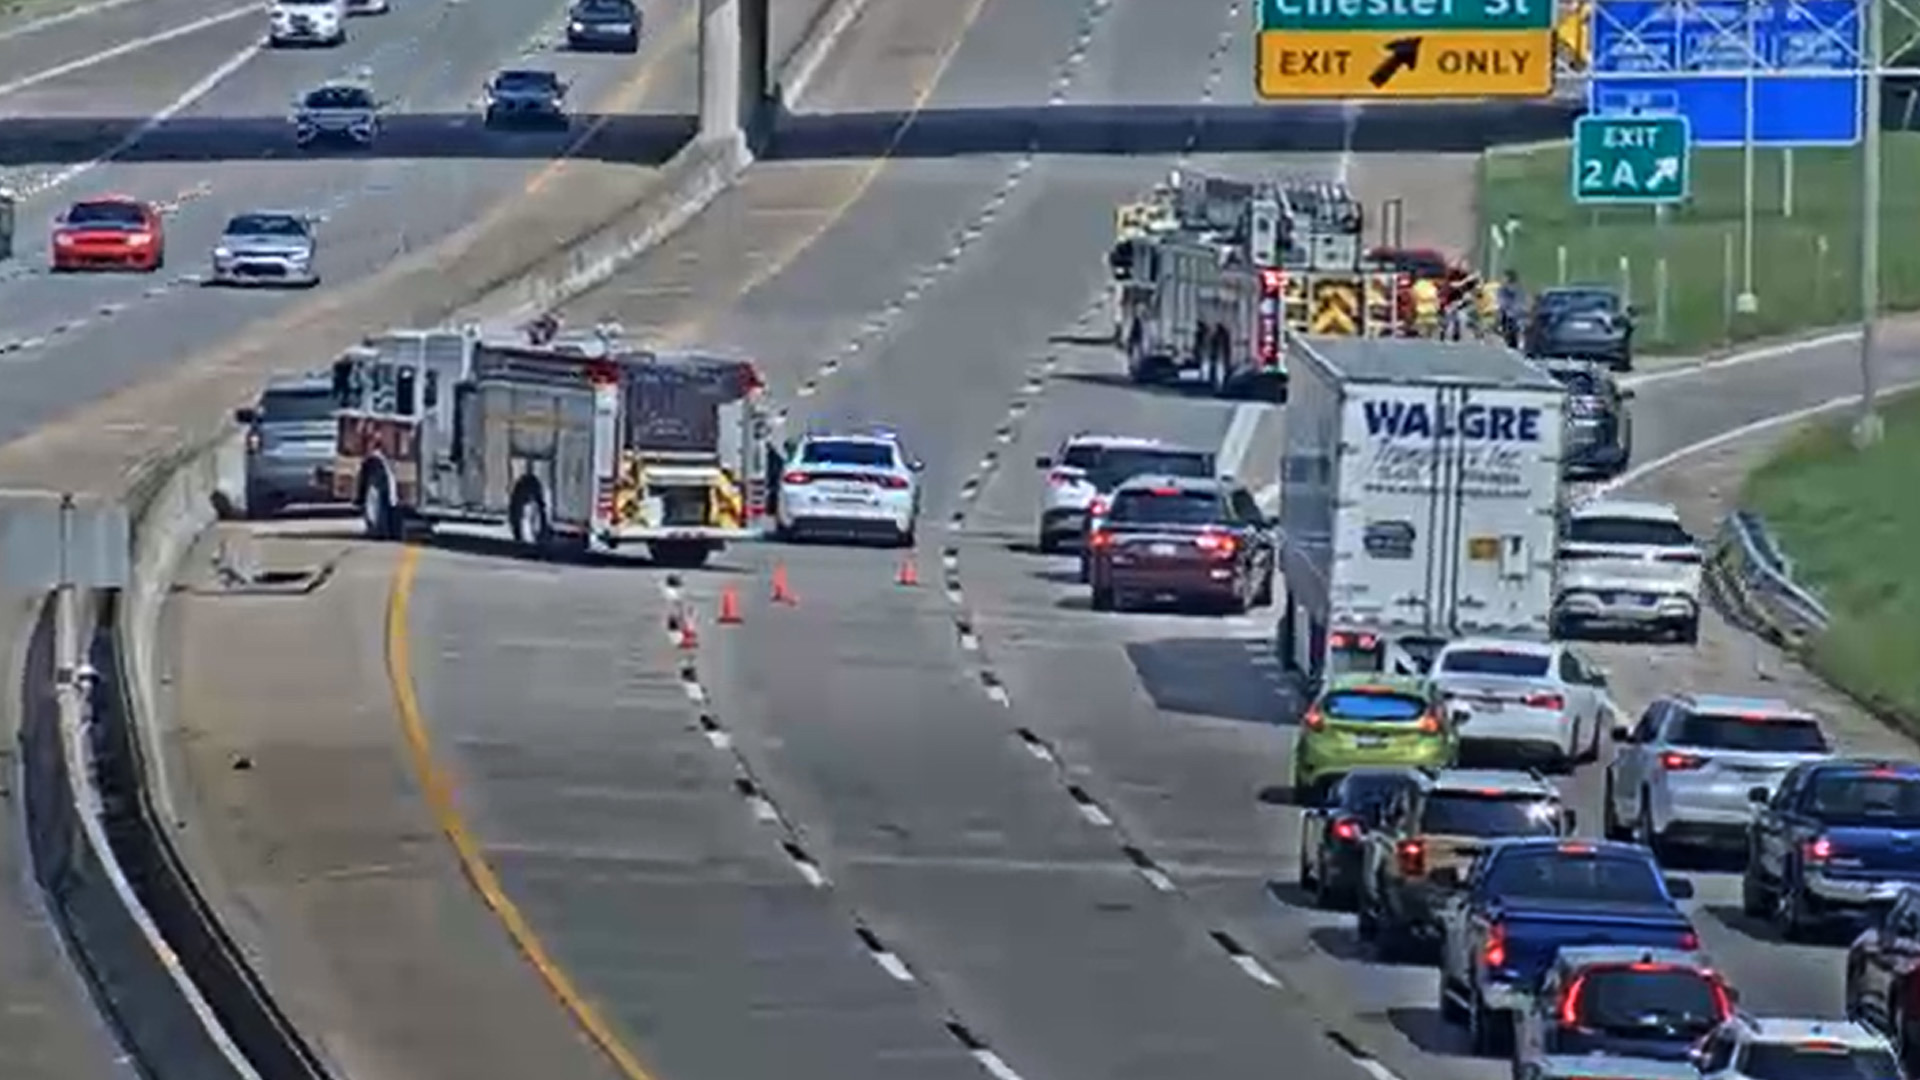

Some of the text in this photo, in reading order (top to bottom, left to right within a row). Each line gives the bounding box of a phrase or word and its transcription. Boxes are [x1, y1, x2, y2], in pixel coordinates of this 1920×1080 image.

[1278, 50, 1531, 75] EXIT ONLY
[1602, 126, 1660, 148] EXIT
[1363, 402, 1542, 441] WALGRE
